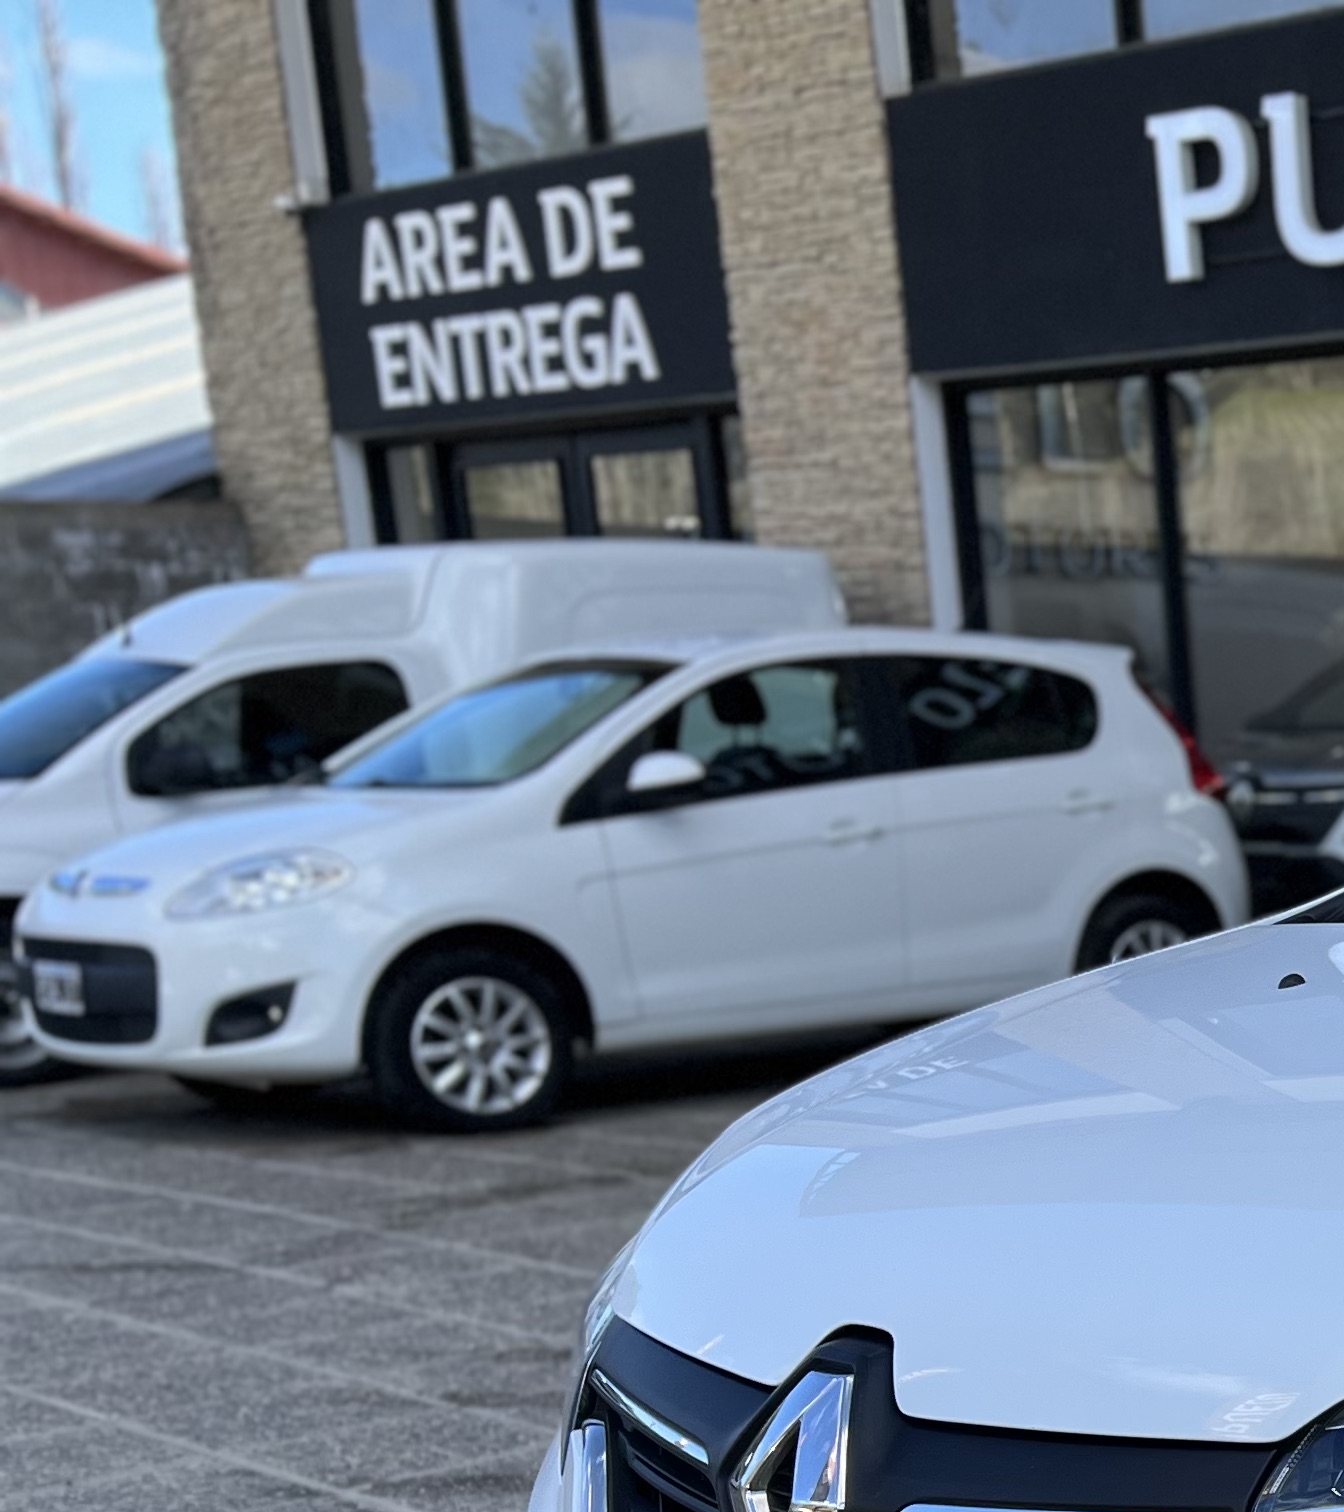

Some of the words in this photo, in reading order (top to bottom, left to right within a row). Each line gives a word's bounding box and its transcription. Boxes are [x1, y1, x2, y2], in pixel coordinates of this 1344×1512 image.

[360, 217, 533, 305] AREA
[536, 174, 644, 280] DE
[367, 291, 661, 410] ENTREGA
